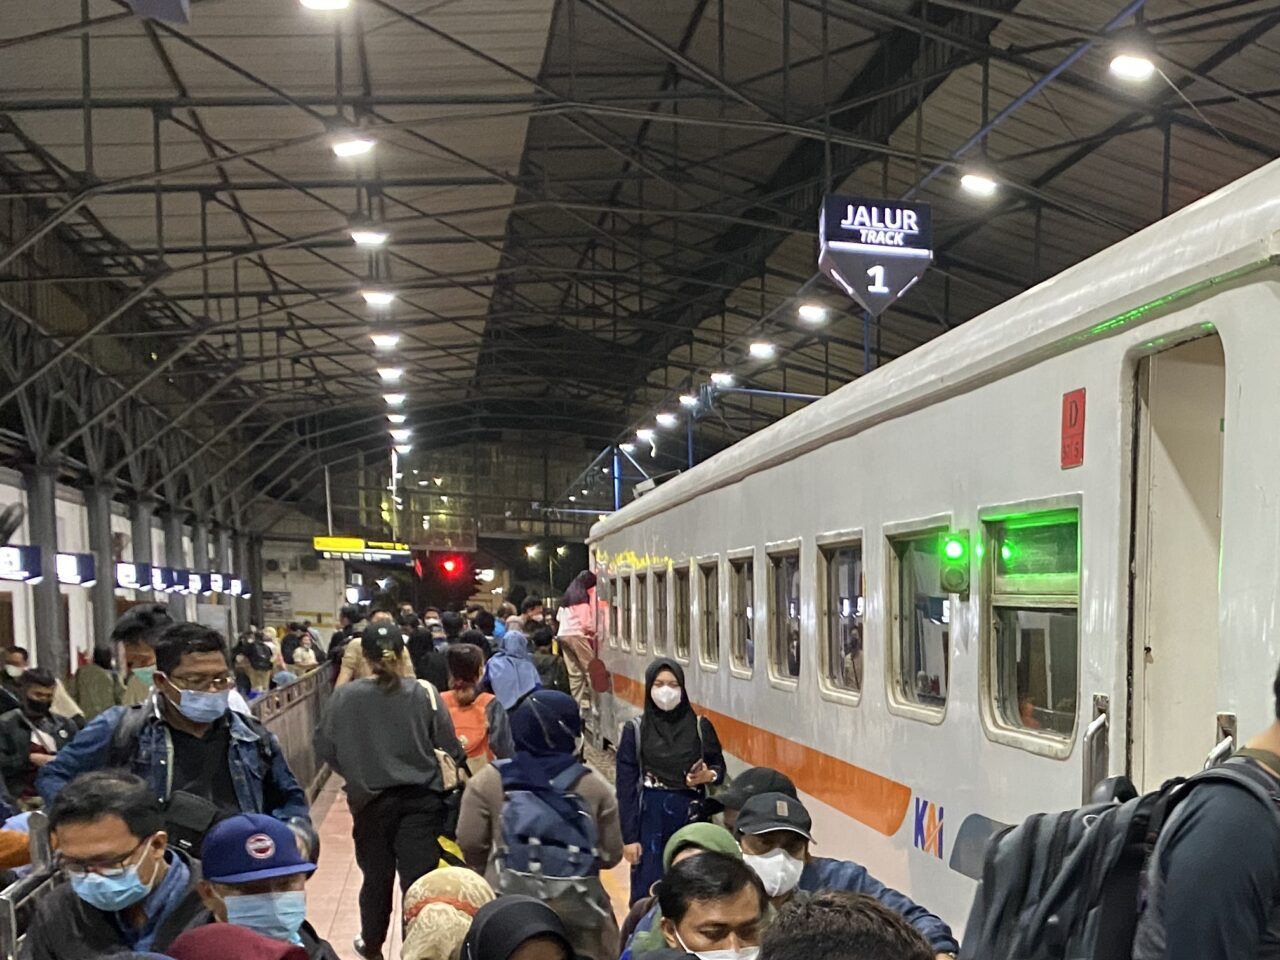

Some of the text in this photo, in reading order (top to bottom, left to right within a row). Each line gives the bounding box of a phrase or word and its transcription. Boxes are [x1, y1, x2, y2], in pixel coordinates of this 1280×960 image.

[841, 204, 919, 230] JALUR
[860, 230, 905, 245] TRACK
[866, 264, 890, 293] 1
[914, 797, 944, 860] KAI
